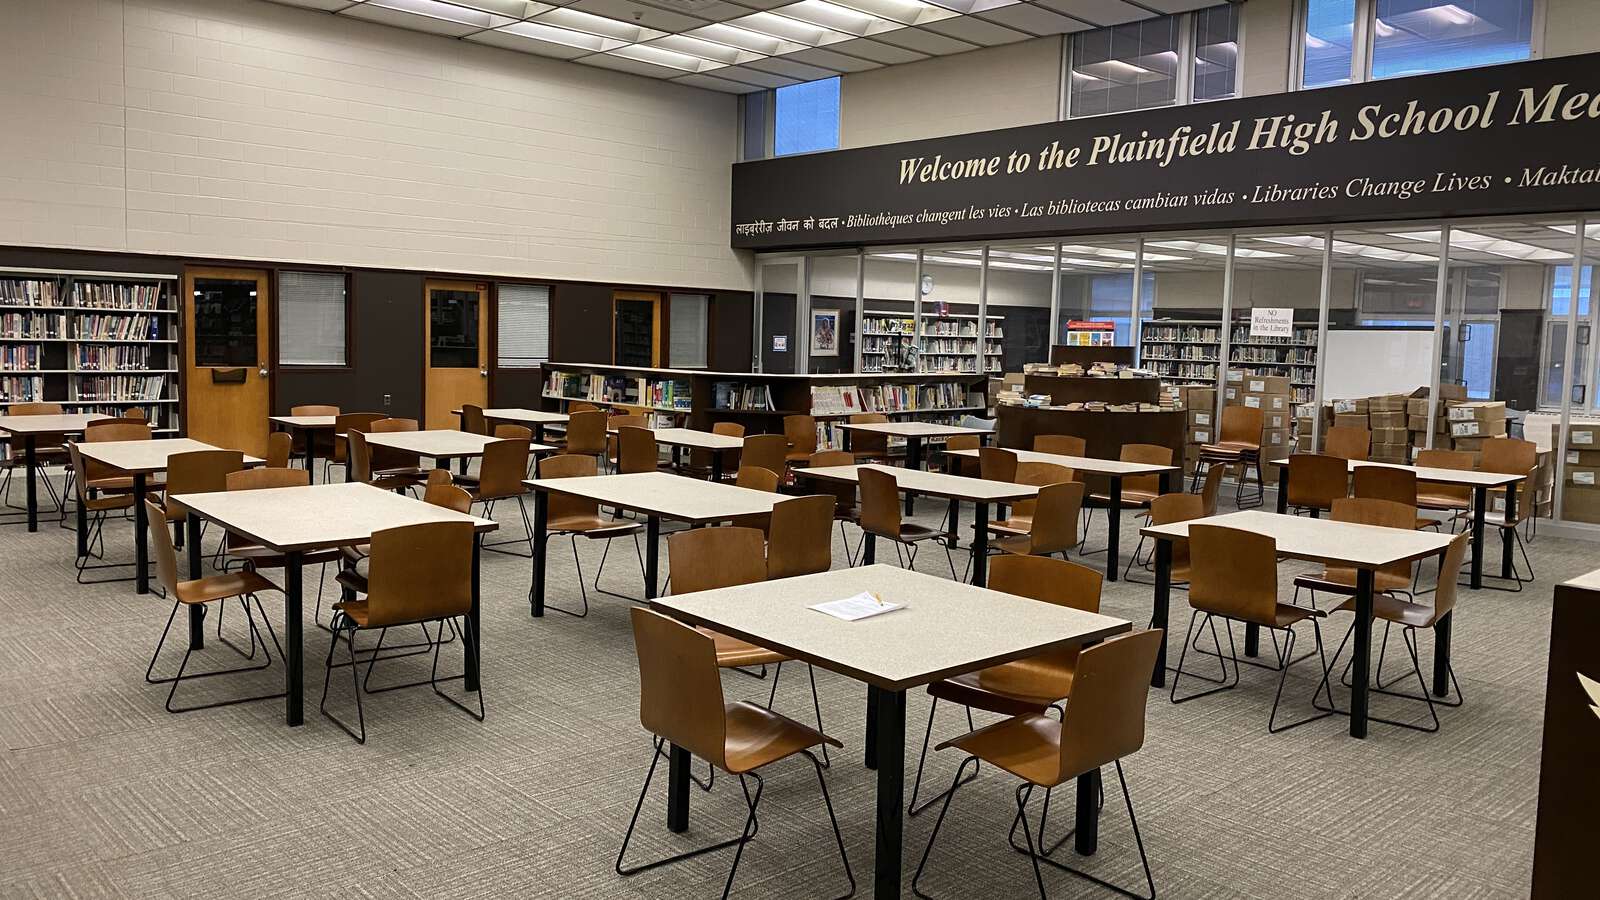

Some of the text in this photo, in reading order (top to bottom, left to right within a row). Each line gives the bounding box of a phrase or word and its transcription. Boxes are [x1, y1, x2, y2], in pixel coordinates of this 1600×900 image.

[899, 154, 1001, 185] Welcome
[1006, 149, 1031, 175] to
[1037, 140, 1081, 172] the
[1086, 119, 1241, 168] Plainfield
[1245, 109, 1339, 156] High
[1349, 90, 1500, 142] School
[1019, 187, 1235, 218] Las bibliotecas cambian vidas
[1250, 172, 1492, 204] Libraries Change Lives
[776, 217, 801, 232] जीवन
[803, 215, 816, 231] को
[818, 217, 840, 230] बदल
[846, 203, 1012, 229] Bibliothèques changent les vies
